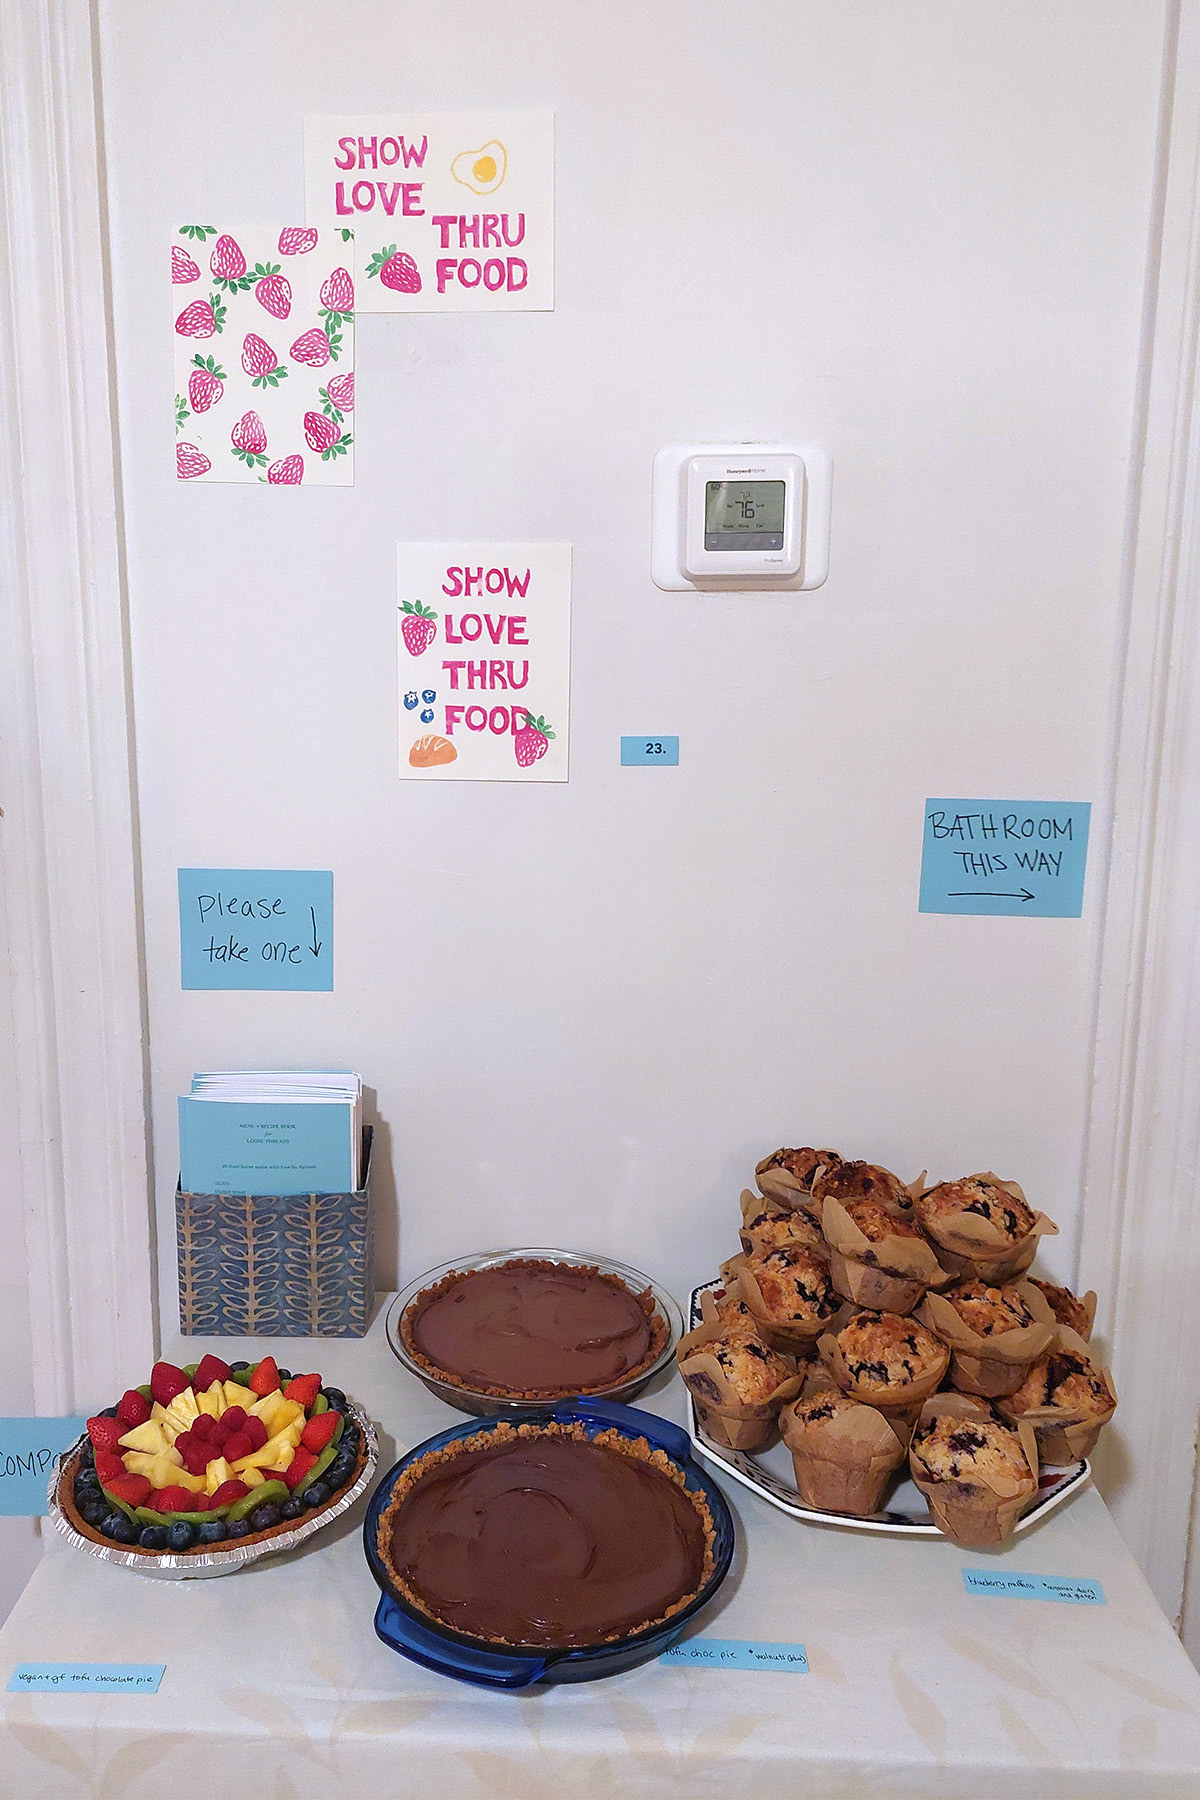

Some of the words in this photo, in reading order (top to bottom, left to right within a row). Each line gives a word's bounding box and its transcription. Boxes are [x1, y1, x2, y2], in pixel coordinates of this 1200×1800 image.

[334, 135, 428, 170] SHOW
[335, 180, 426, 217] LOVE
[431, 213, 526, 248] THRU
[436, 256, 528, 293] FOOD
[735, 501, 755, 518] 76
[441, 566, 531, 598] SHOW
[444, 613, 530, 645] LOVE
[441, 660, 530, 690] THRU
[444, 704, 531, 736] FOOD
[645, 742, 667, 754] 23.
[927, 811, 1073, 841] BATHROOM
[953, 851, 1008, 877] THIS
[1014, 849, 1063, 877] WAY
[202, 935, 249, 963] take
[261, 941, 302, 964] one
[690, 1648, 717, 1658] choc
[720, 1651, 738, 1660] pie
[70, 1672, 91, 1682] tofu
[95, 1674, 134, 1683] chocolate
[136, 1675, 154, 1685] pie
